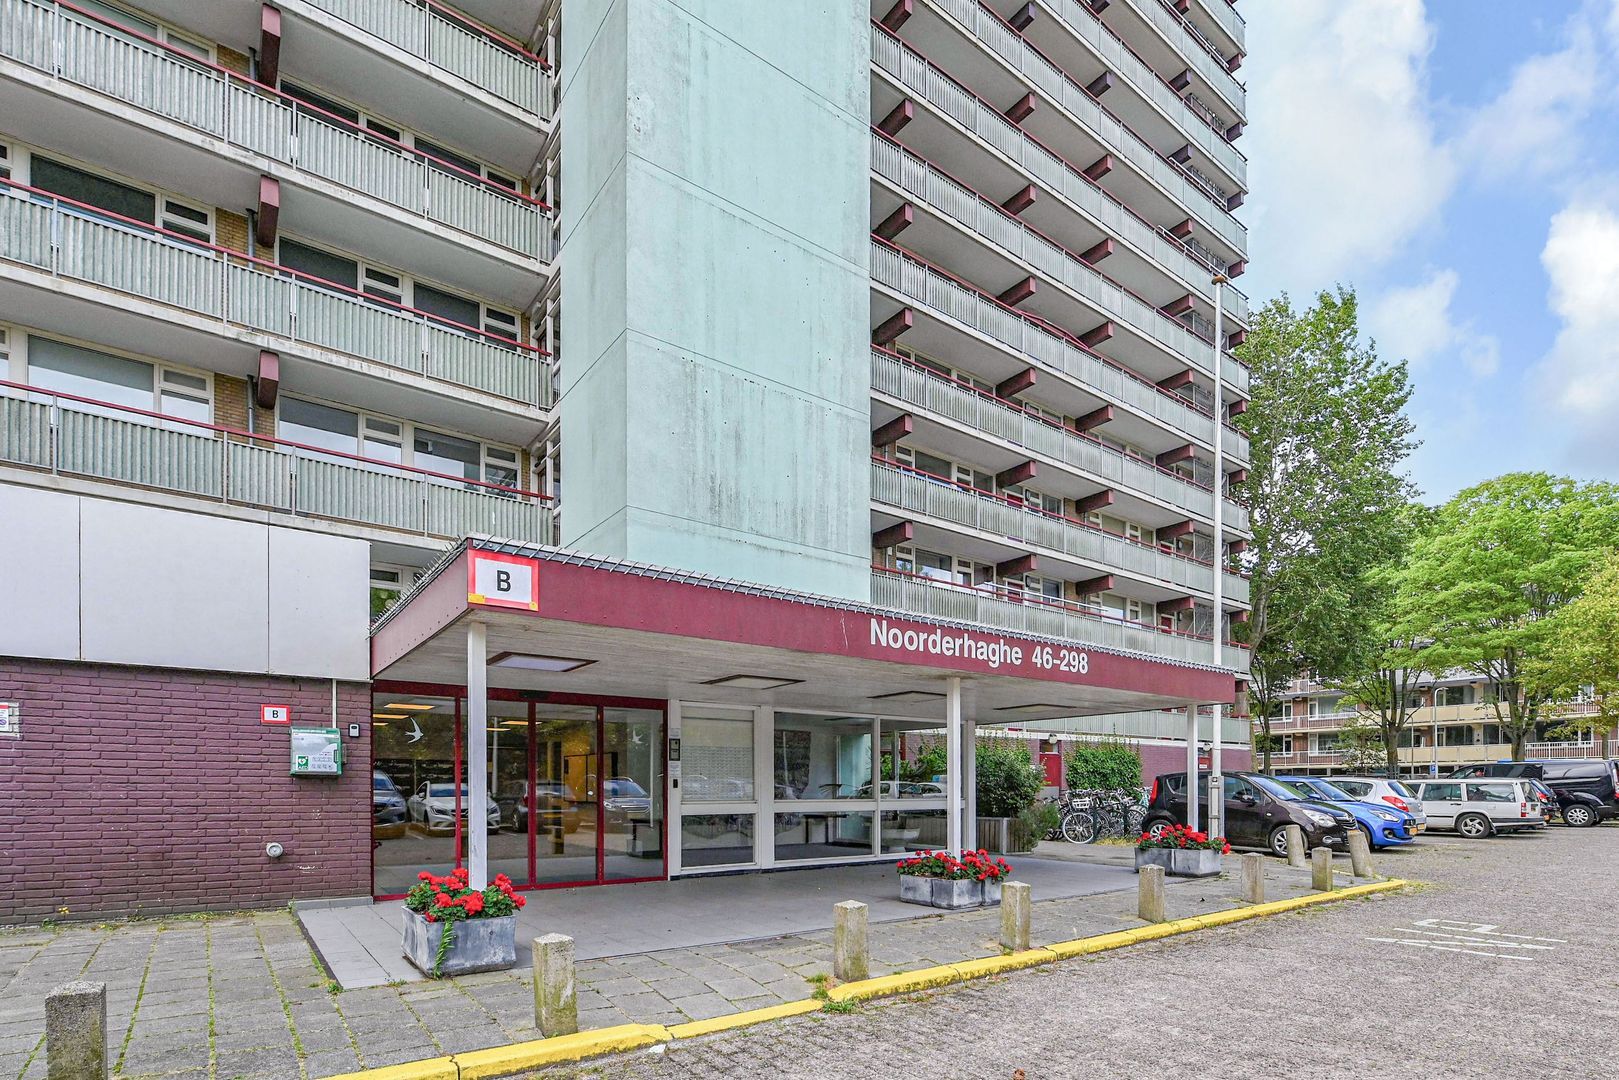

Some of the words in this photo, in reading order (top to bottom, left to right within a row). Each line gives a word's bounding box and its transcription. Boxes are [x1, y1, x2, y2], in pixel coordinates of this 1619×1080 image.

[497, 570, 511, 592] B
[870, 618, 1023, 668] Noorderhaghe
[1031, 646, 1089, 675] 46-298
[272, 710, 279, 718] B
